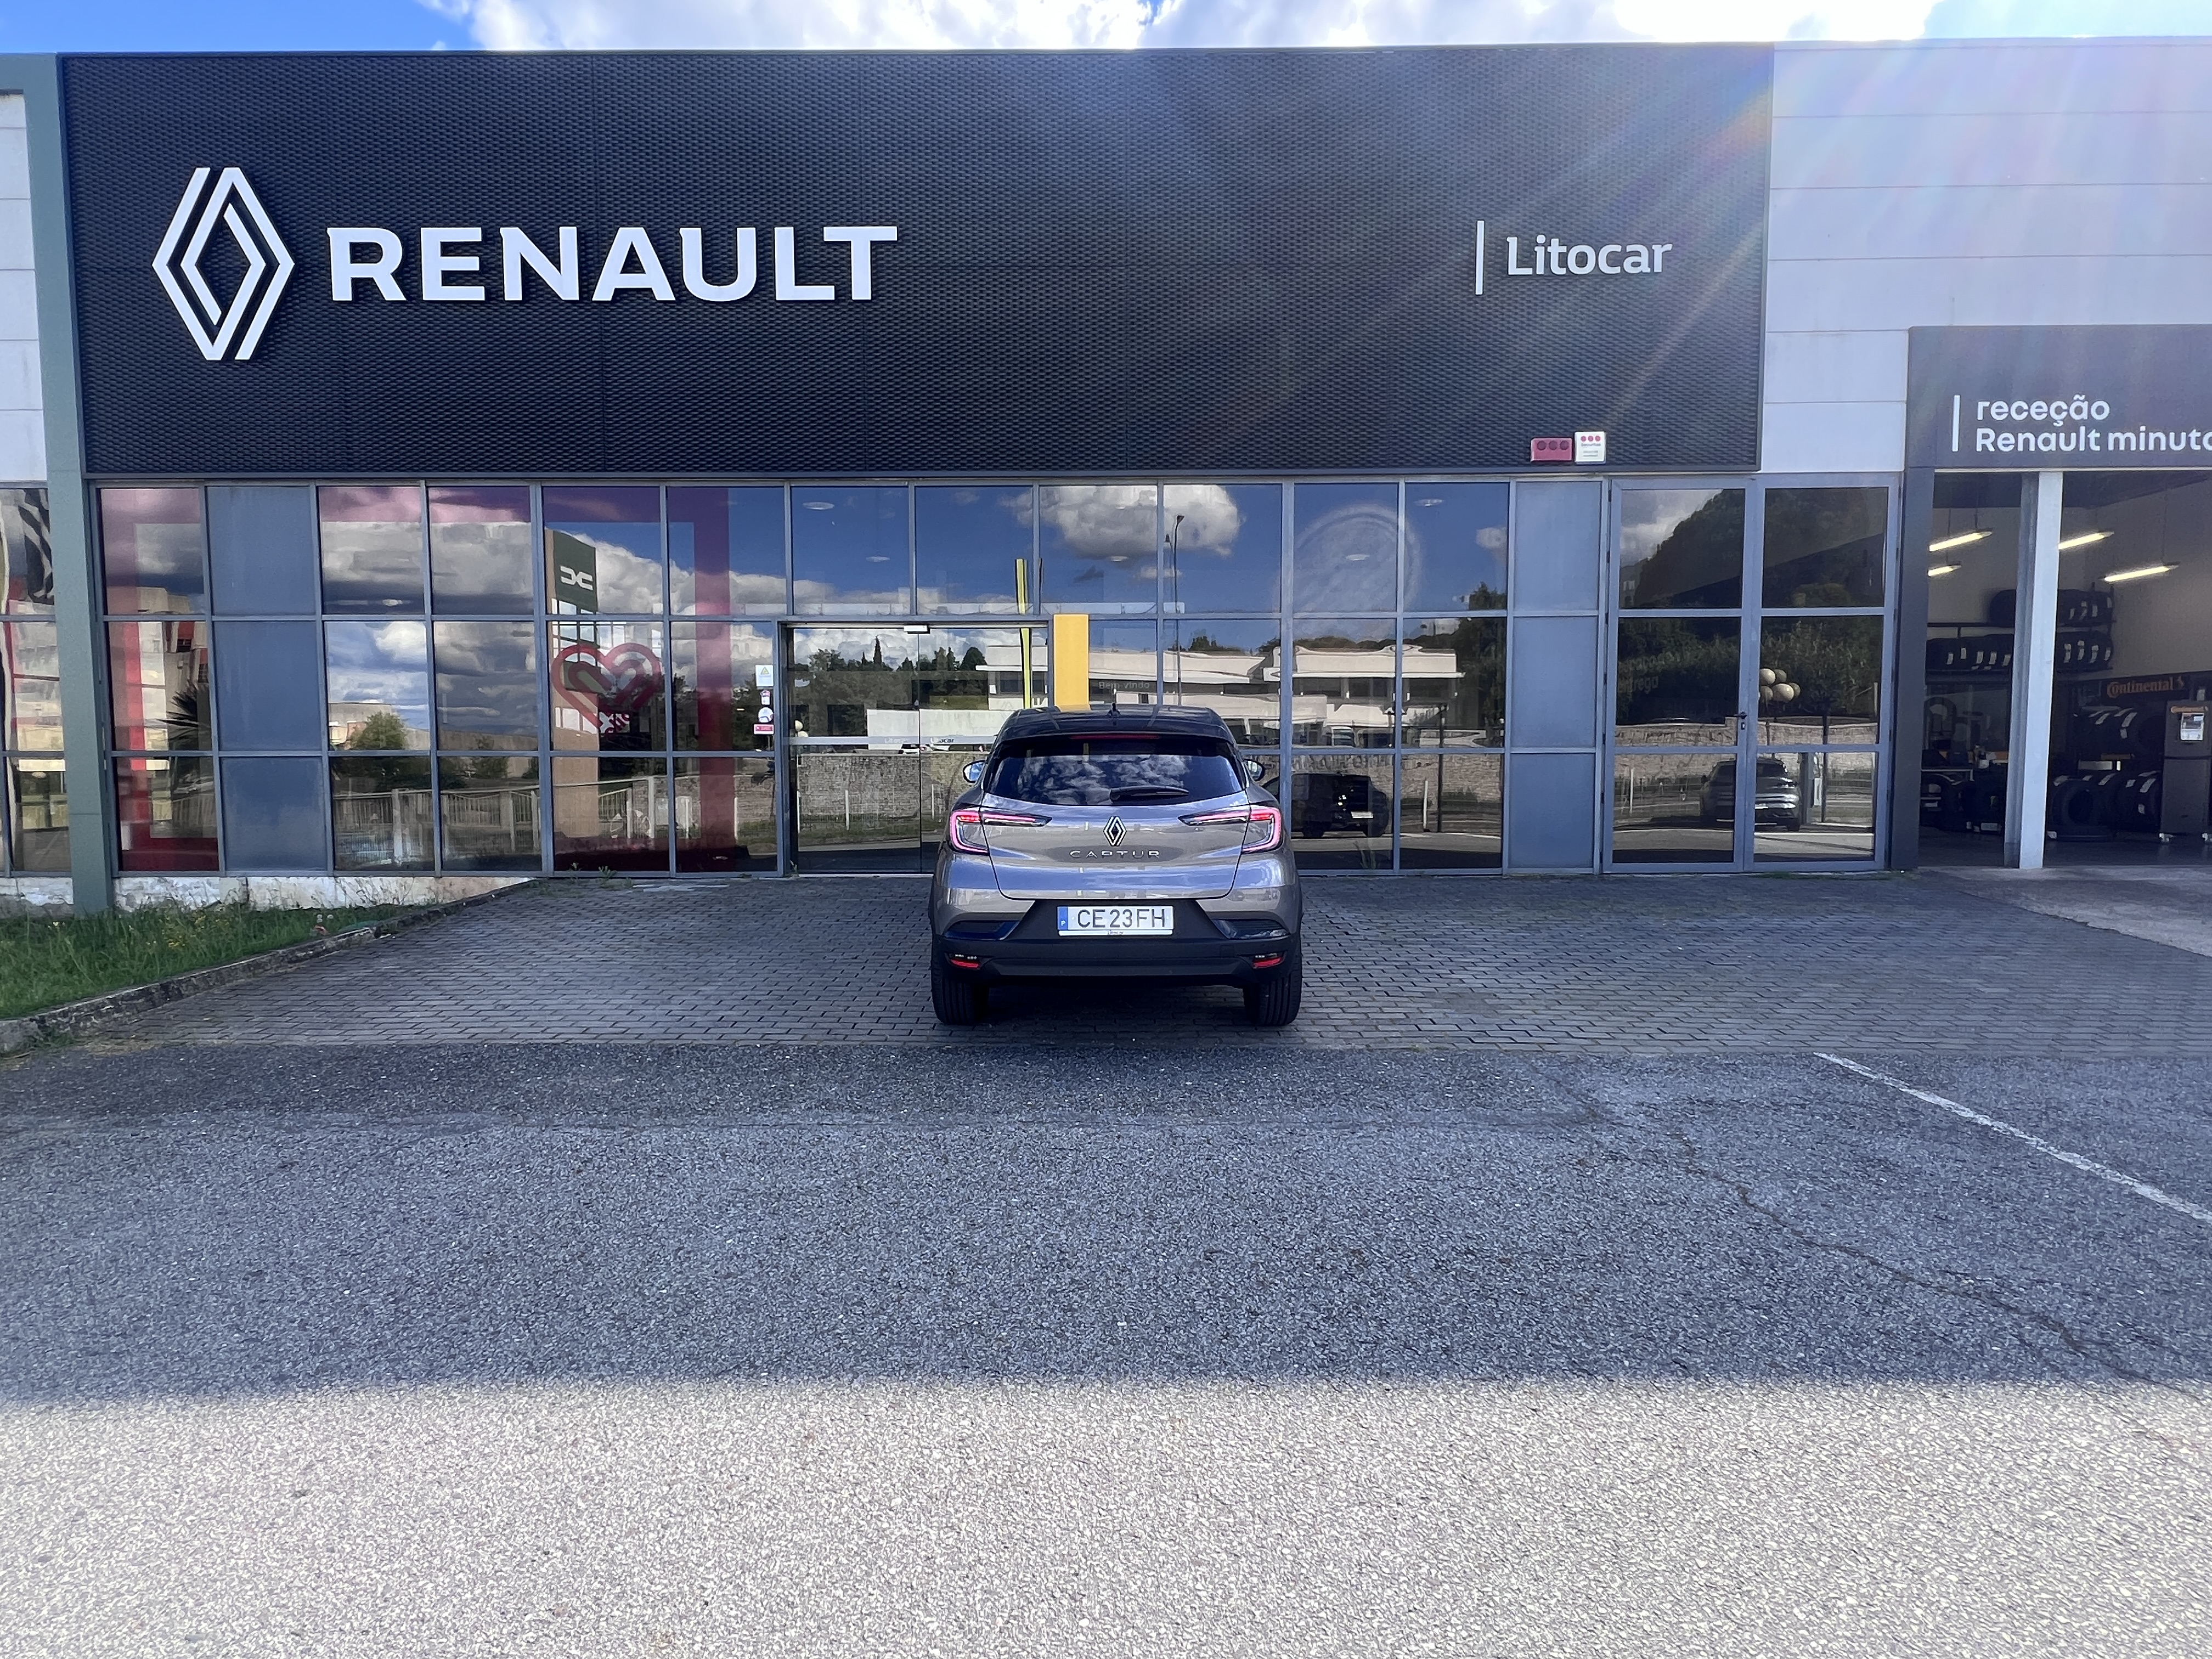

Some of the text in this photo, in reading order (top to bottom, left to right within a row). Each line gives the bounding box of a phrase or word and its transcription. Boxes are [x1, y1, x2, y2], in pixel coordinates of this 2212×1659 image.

[326, 225, 898, 302] RENAULT
[1506, 234, 1673, 275] Litocar
[1977, 394, 2110, 426] receção
[1976, 426, 2101, 452] Renault
[2107, 676, 2174, 698] Continental
[1070, 850, 1159, 859] CAPTUR
[1077, 909, 1165, 928] CE23FH
